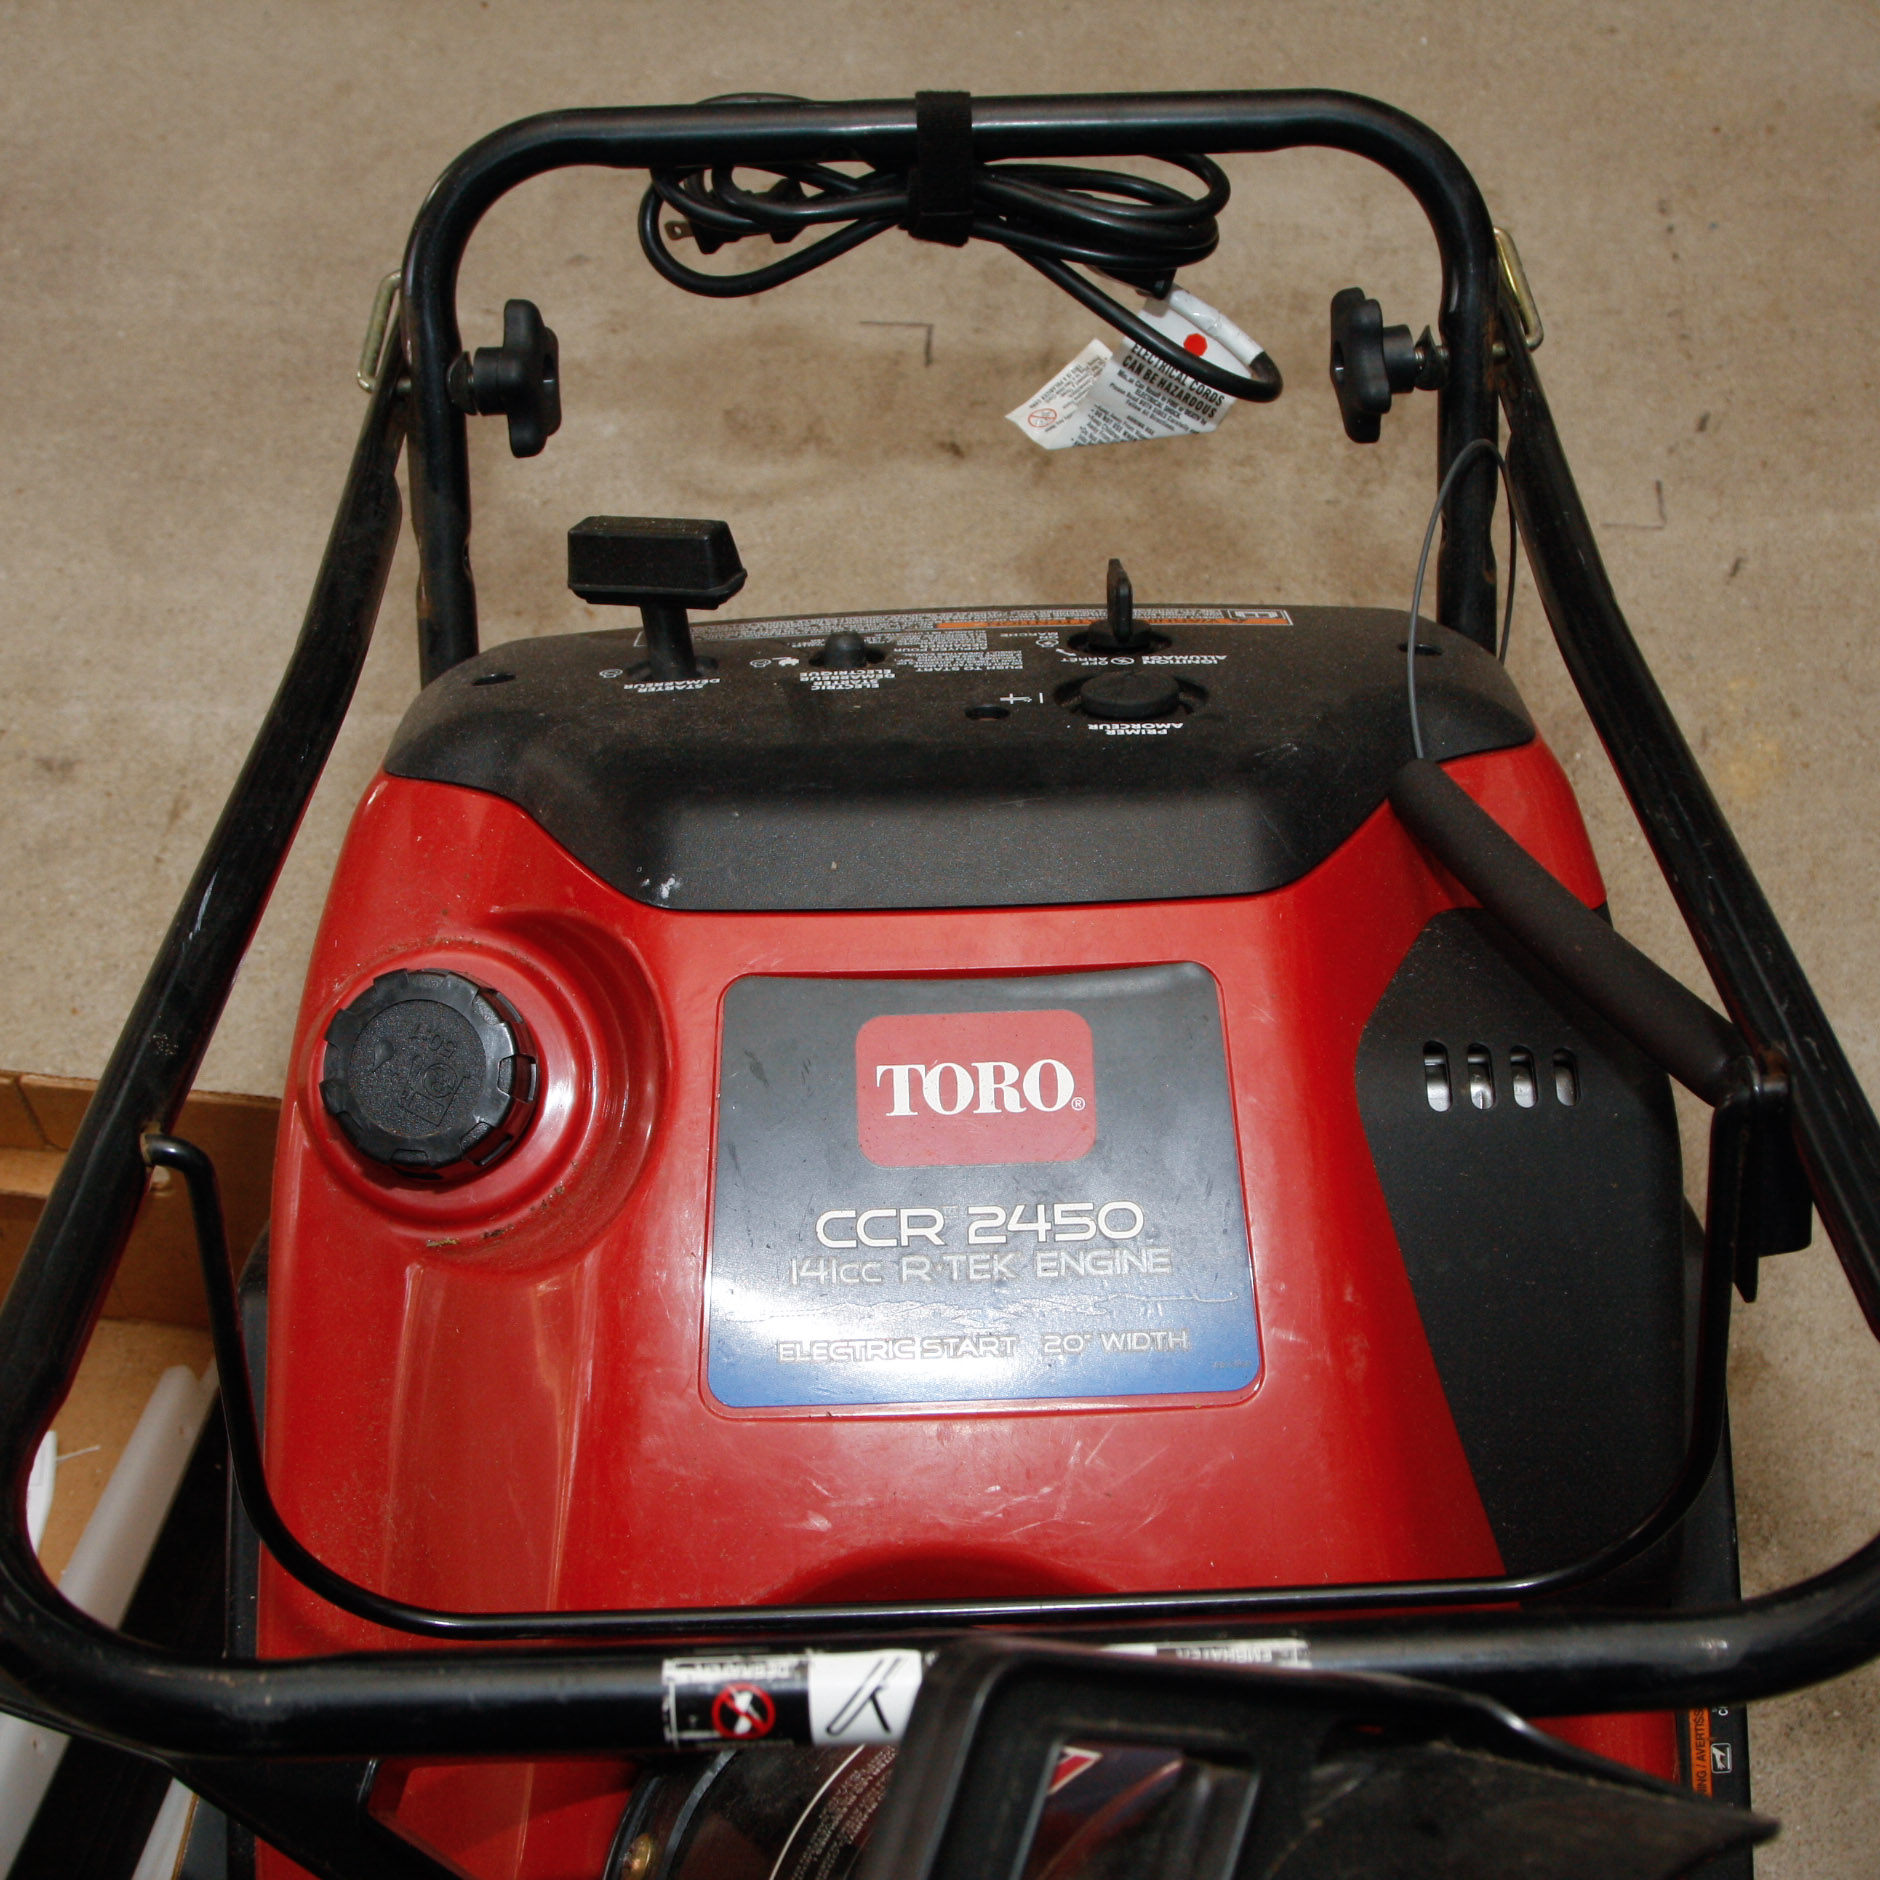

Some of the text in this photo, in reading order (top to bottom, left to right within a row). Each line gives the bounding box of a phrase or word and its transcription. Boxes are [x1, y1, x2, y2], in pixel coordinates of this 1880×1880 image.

[1120, 354, 1219, 420] CAN BE HAZARDOUS
[1128, 343, 1192, 386] ELECTRICAL
[1188, 379, 1226, 408] CORDS
[637, 684, 703, 693] STARTER
[816, 1200, 1145, 1248] CCR 2450
[1036, 1247, 1172, 1278] ENGINE
[778, 1338, 916, 1362] ELECTRIC
[919, 1335, 1018, 1359] START
[1100, 1329, 1191, 1354] WIDTH
